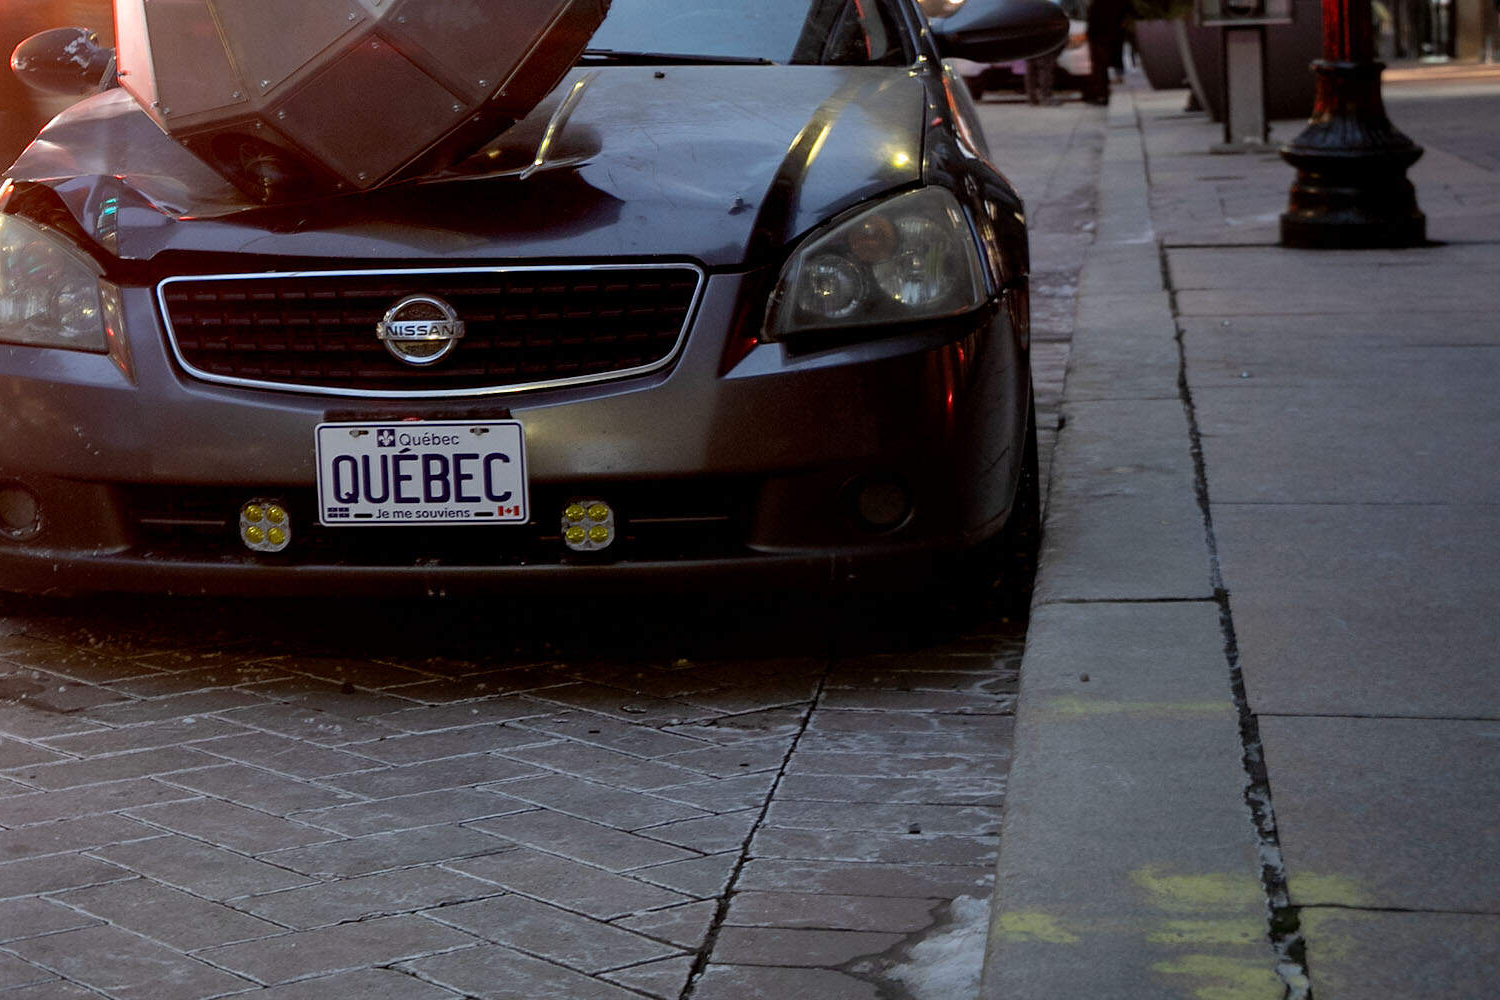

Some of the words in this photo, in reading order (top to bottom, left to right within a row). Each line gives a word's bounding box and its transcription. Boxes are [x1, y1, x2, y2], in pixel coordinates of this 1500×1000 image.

[385, 325, 455, 337] NISSAN
[399, 432, 460, 447] Québec
[331, 448, 512, 504] QUÉBEC
[375, 507, 389, 520] Je
[392, 509, 412, 519] me
[415, 507, 471, 519] souviens
